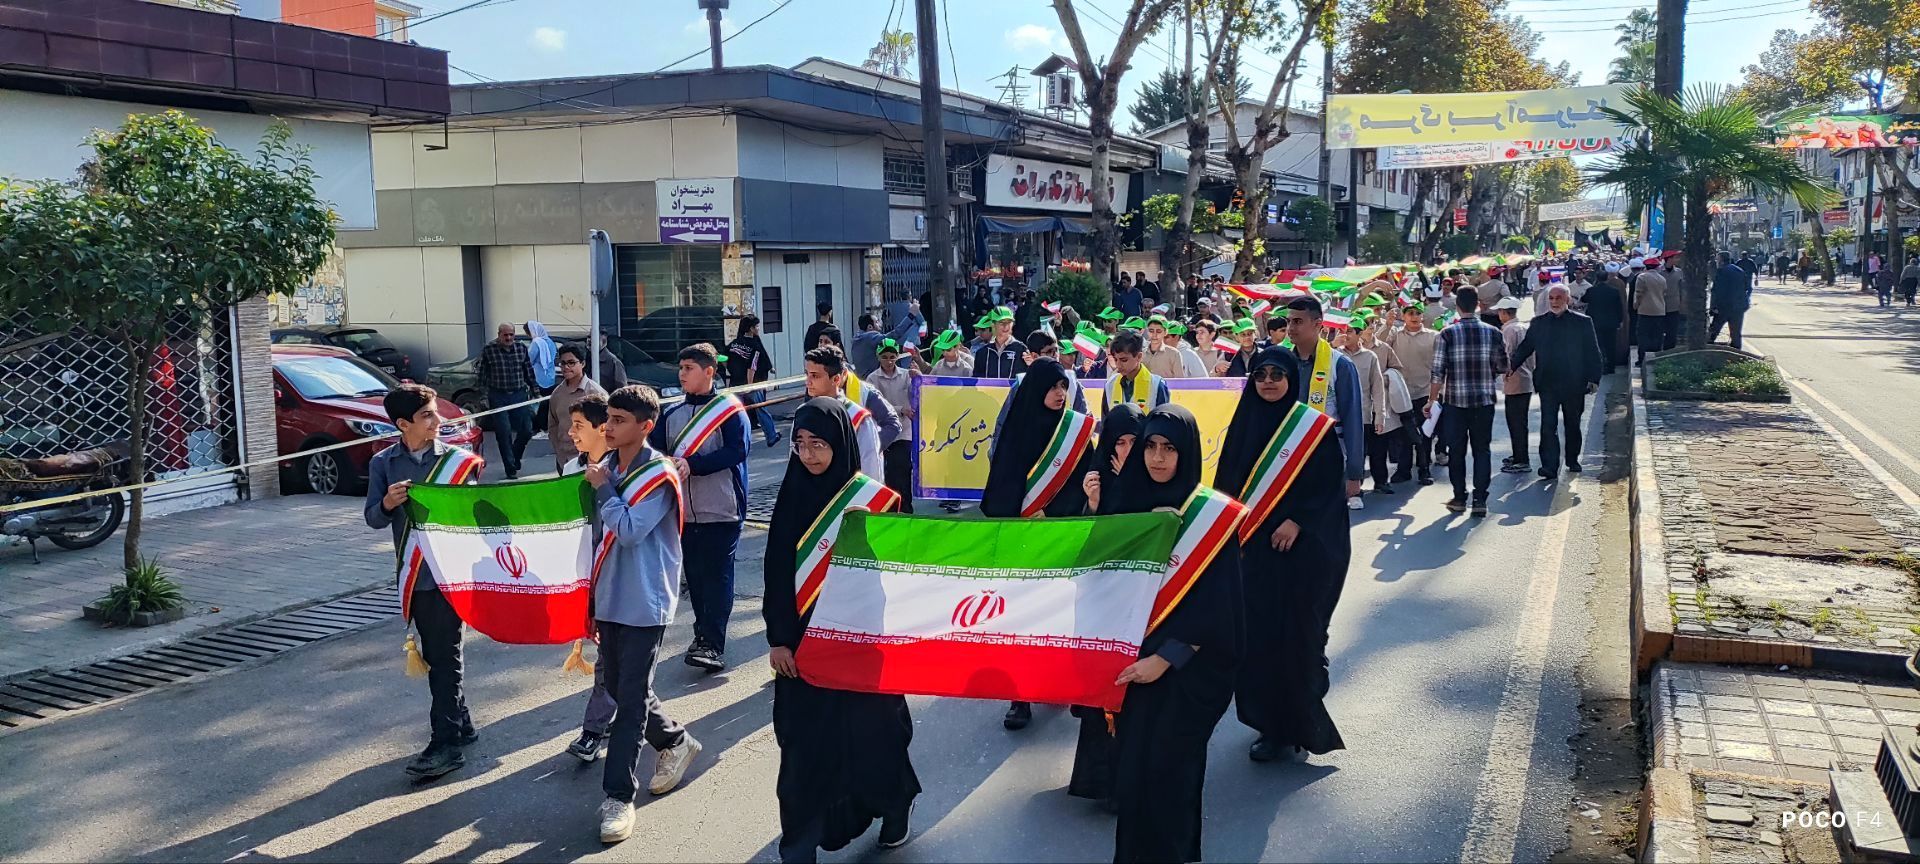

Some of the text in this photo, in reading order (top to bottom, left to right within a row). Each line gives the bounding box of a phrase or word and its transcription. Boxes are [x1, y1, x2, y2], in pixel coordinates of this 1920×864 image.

[671, 184, 714, 197] دفتر پیشخوان
[672, 198, 713, 214] مهراد
[661, 218, 729, 231] محل تعویض شناسنامه
[418, 235, 431, 243] ملت
